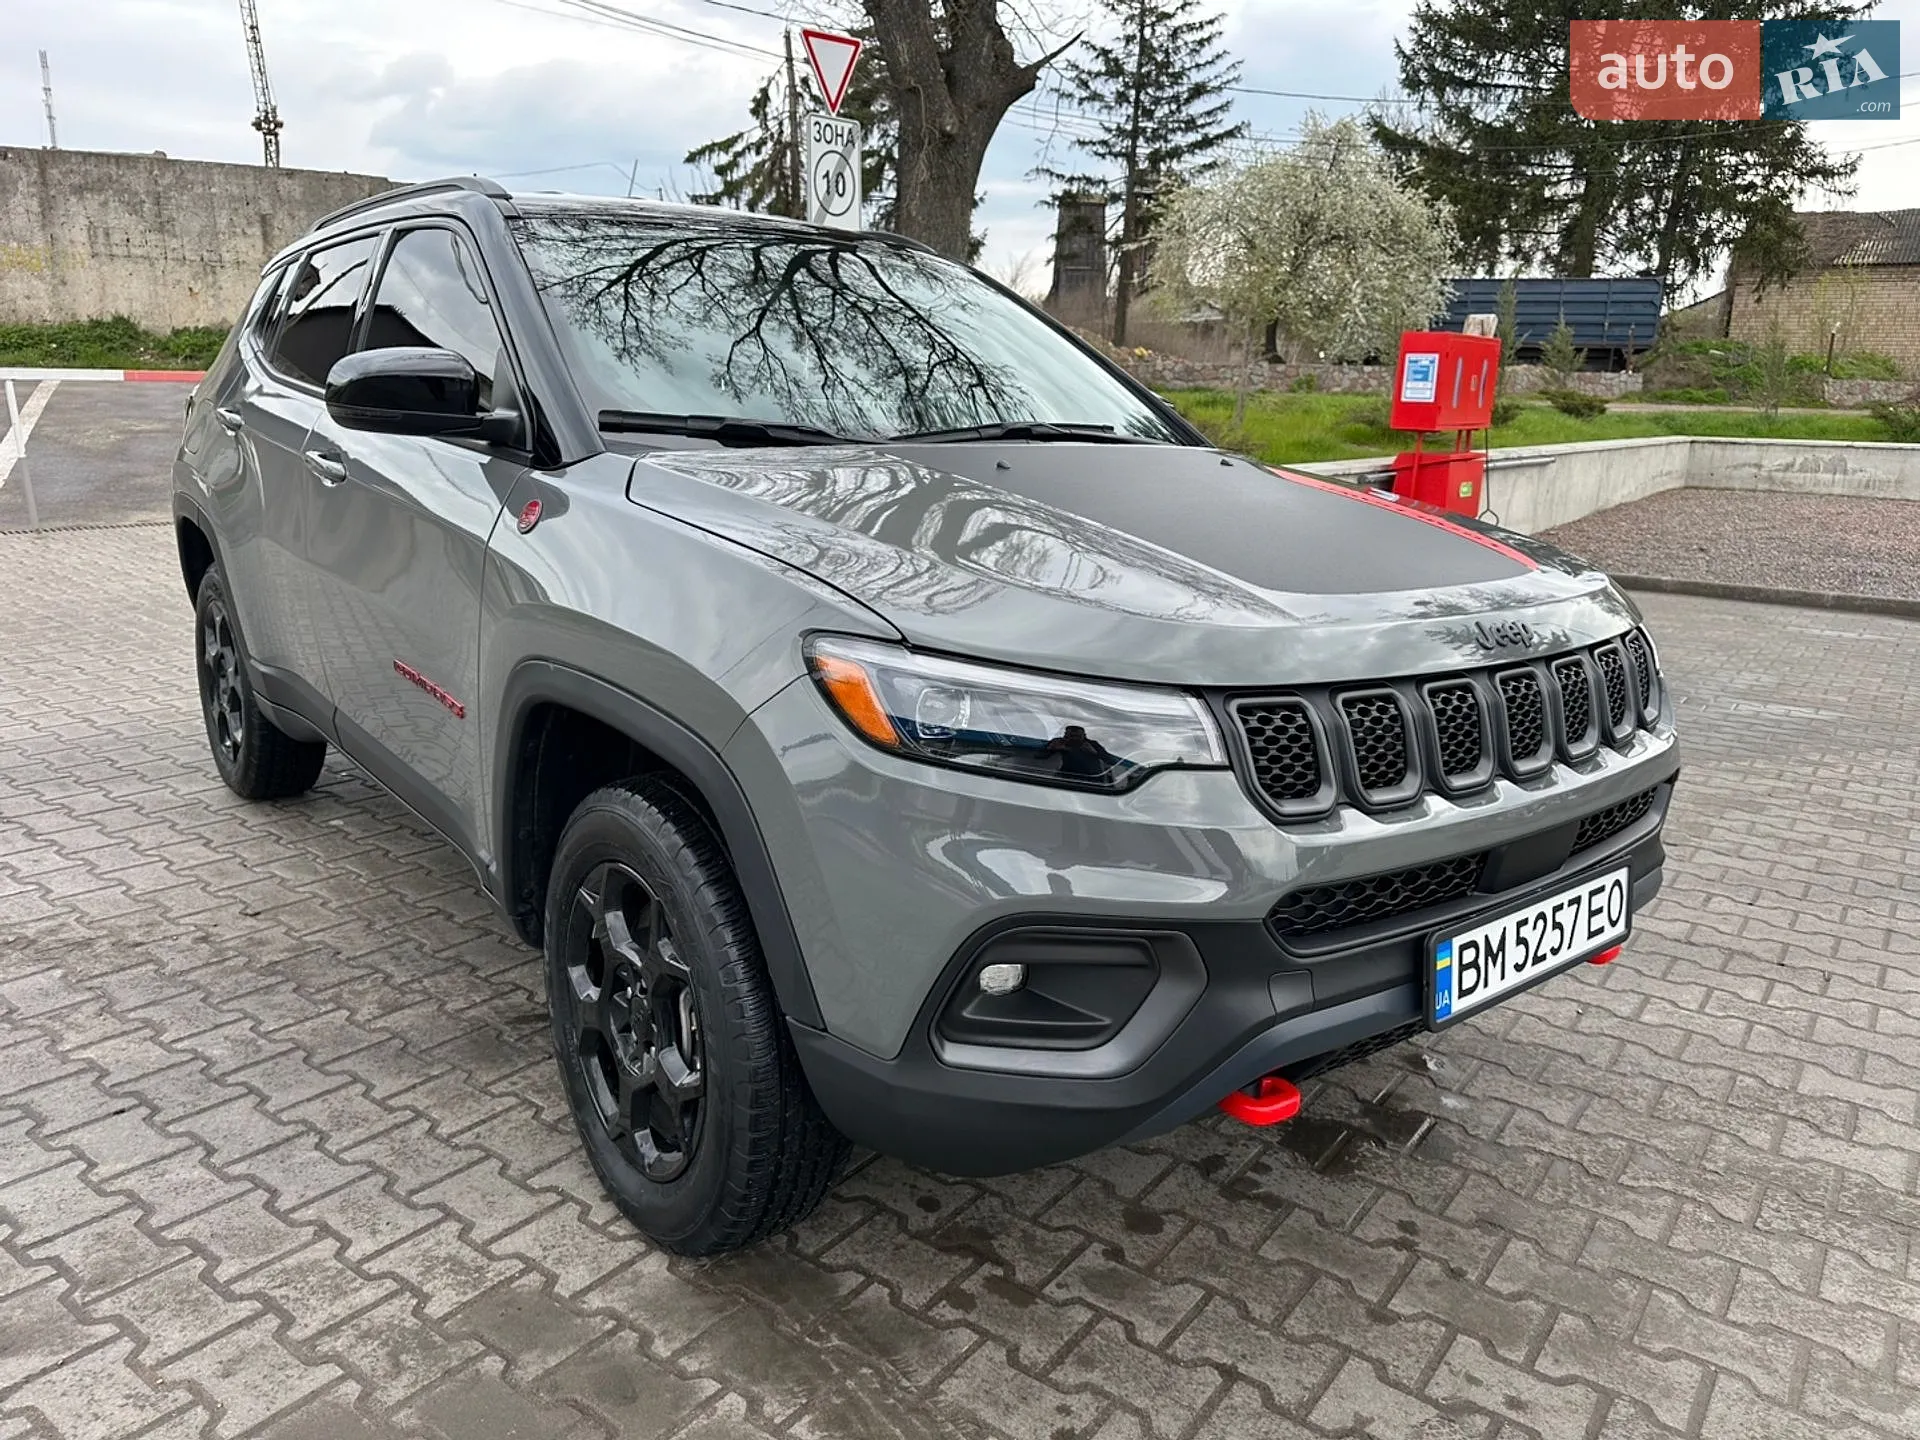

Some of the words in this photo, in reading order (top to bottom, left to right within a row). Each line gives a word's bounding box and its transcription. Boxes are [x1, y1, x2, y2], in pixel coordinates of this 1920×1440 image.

[813, 121, 855, 148] ЗОНА
[822, 169, 846, 197] 10
[1475, 621, 1534, 650] Jeep
[1458, 926, 1506, 1000] BM
[1513, 895, 1582, 973] 5257
[1587, 879, 1624, 941] EO
[1435, 990, 1450, 1010] UA
